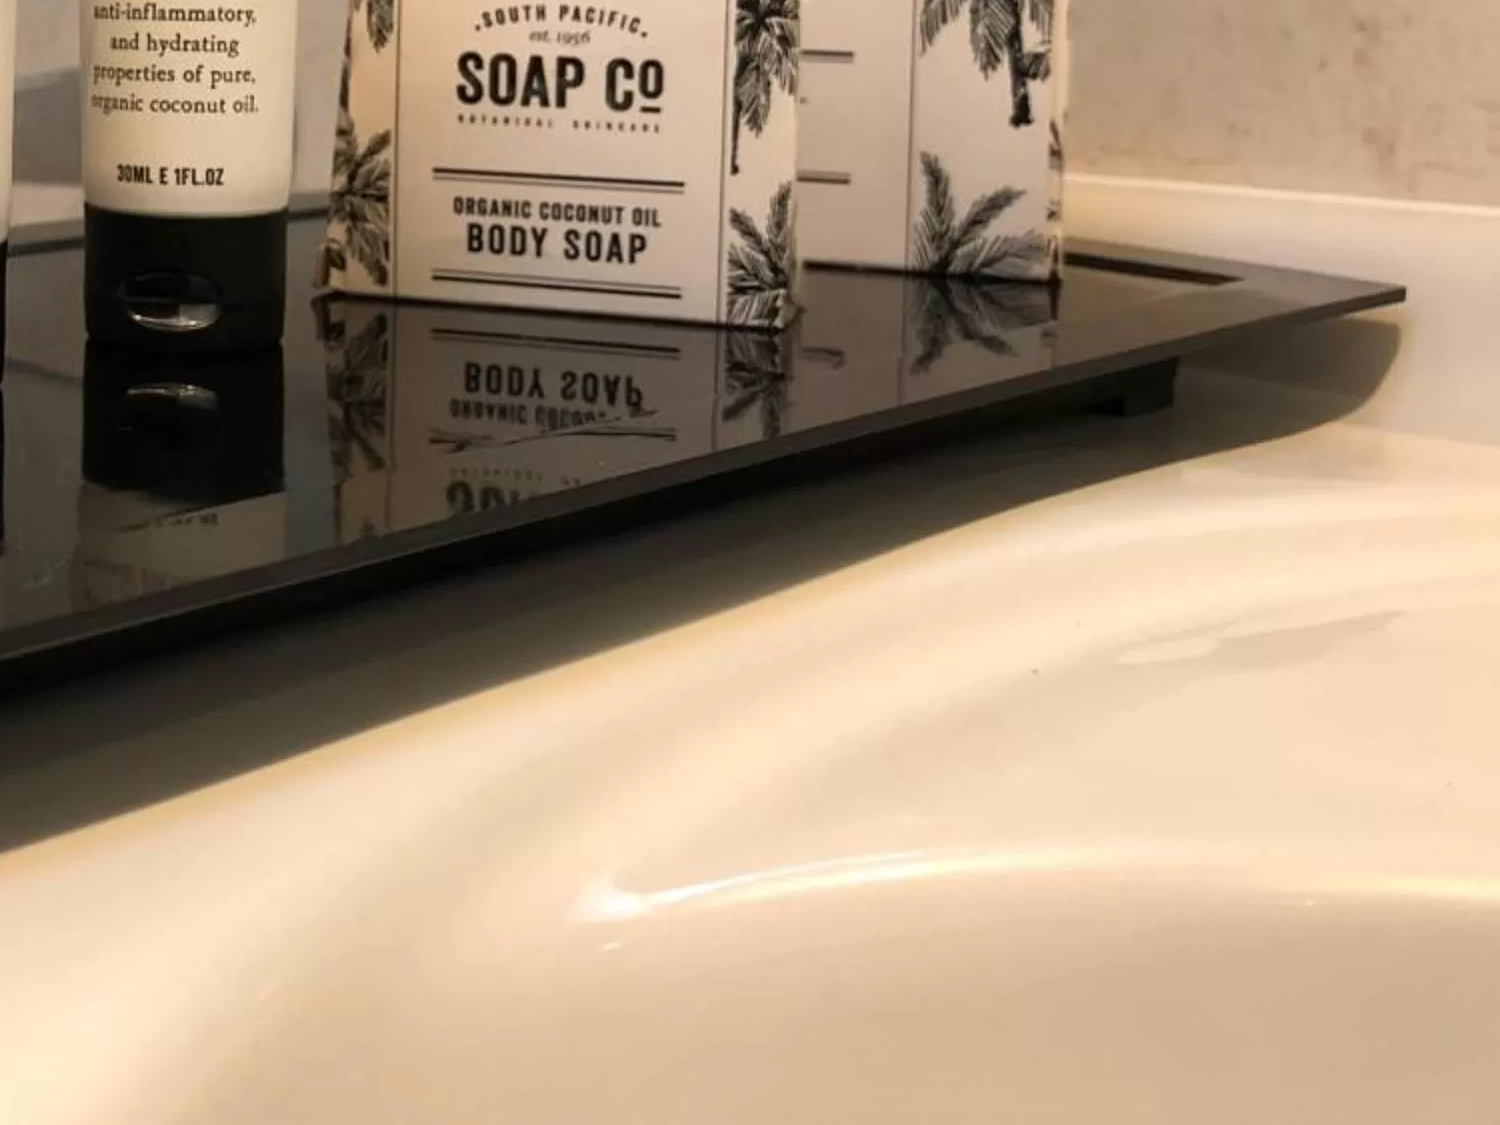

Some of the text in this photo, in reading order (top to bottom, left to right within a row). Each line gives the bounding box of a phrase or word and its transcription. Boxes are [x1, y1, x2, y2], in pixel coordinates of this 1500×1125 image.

[93, 3, 257, 27] anti-inflammatory,
[481, 4, 641, 33] SOUTH PACIFIC
[110, 33, 239, 57] and hydrating
[93, 64, 176, 85] properties
[183, 64, 205, 83] of
[456, 50, 585, 109] SOAP
[91, 94, 259, 116] organic coconut oil.
[117, 163, 153, 185] 30ML
[453, 195, 661, 228] ORGANIC COCONUT OIL
[467, 222, 647, 264] BODY SOAP
